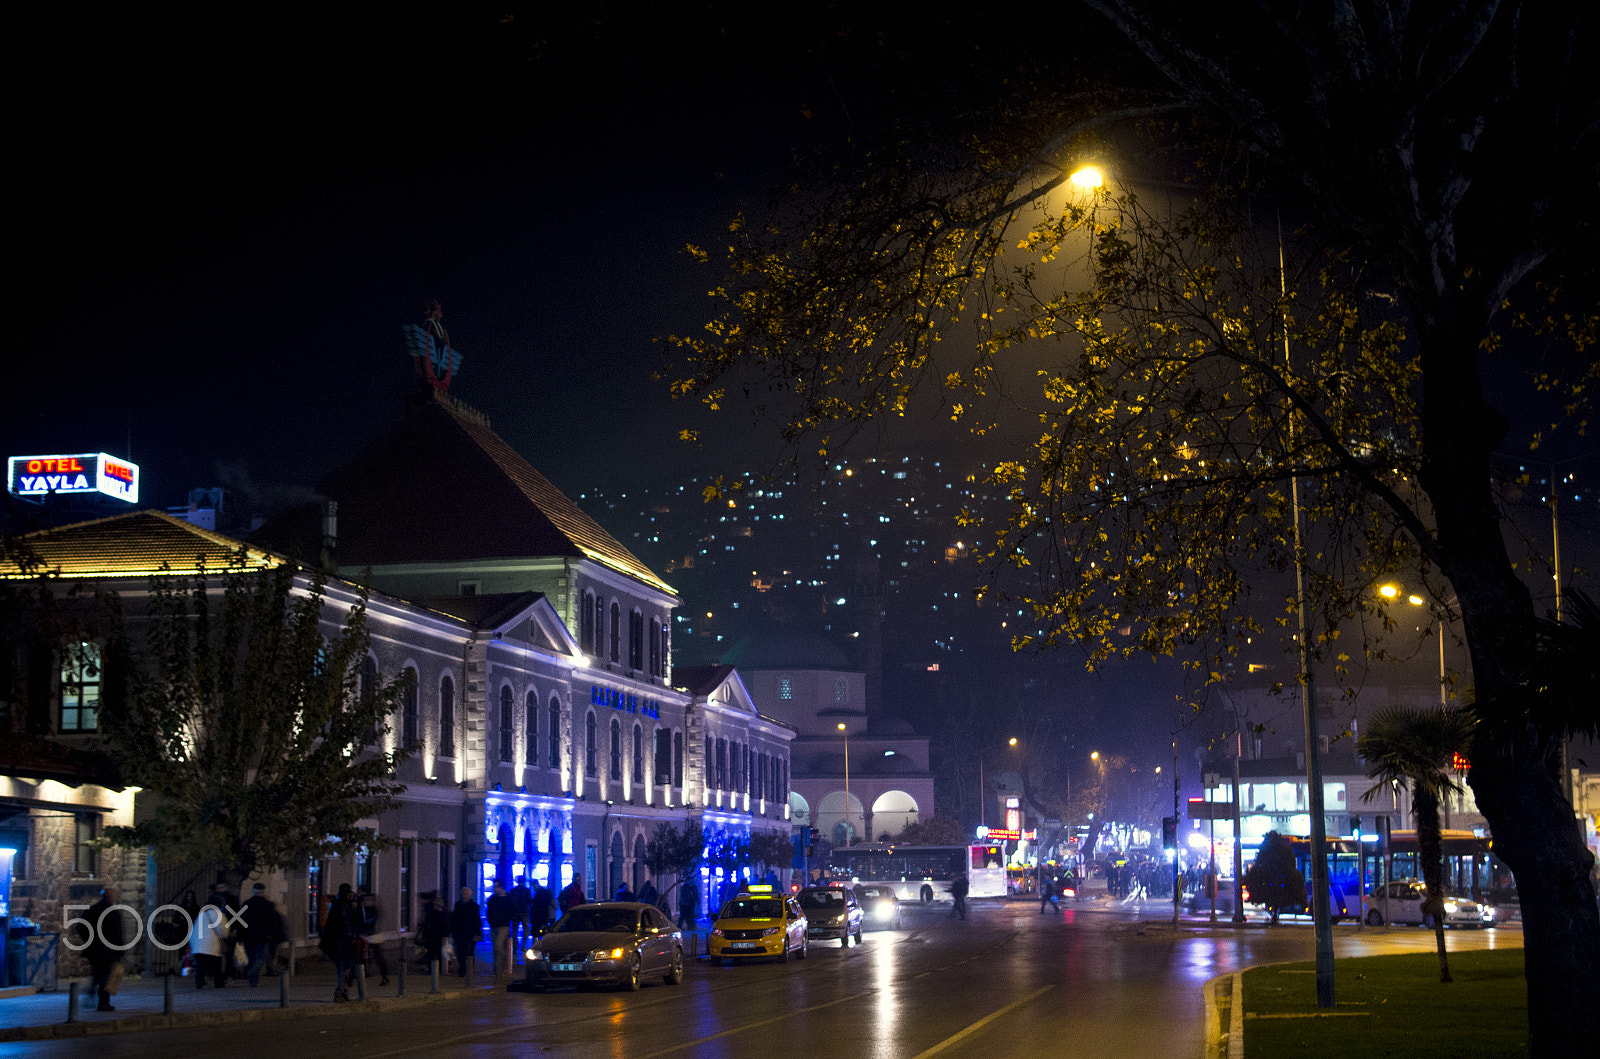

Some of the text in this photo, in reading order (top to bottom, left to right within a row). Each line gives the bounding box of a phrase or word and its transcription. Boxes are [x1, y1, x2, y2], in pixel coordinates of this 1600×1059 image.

[27, 457, 83, 474] OTEL
[105, 461, 133, 481] OTEL
[20, 474, 88, 490] YAYLA
